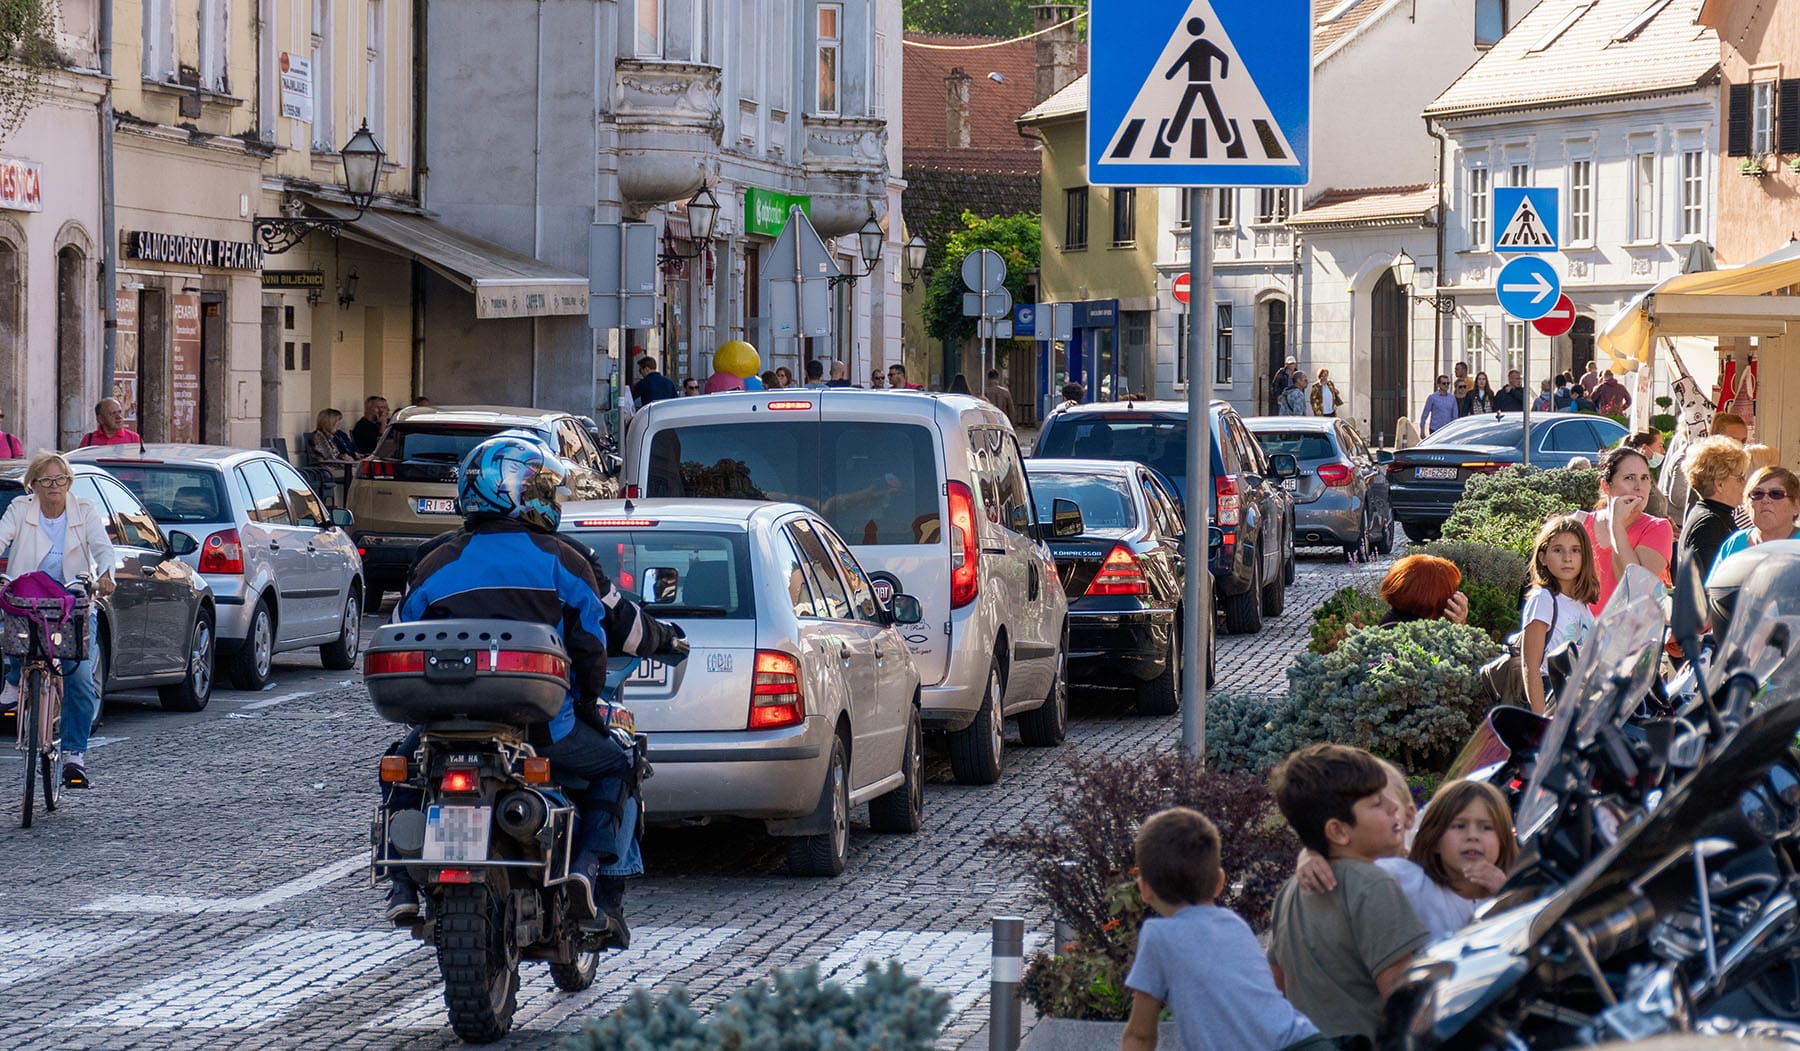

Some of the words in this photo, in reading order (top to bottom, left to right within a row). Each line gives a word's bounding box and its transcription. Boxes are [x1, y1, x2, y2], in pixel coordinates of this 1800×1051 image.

[0, 165, 41, 203] ESNICA
[138, 232, 213, 266] SAMOBORSKA
[218, 242, 265, 270] PEKARNA
[261, 274, 279, 285] AVNI
[116, 298, 136, 312] EKARNA
[425, 500, 437, 511] RI
